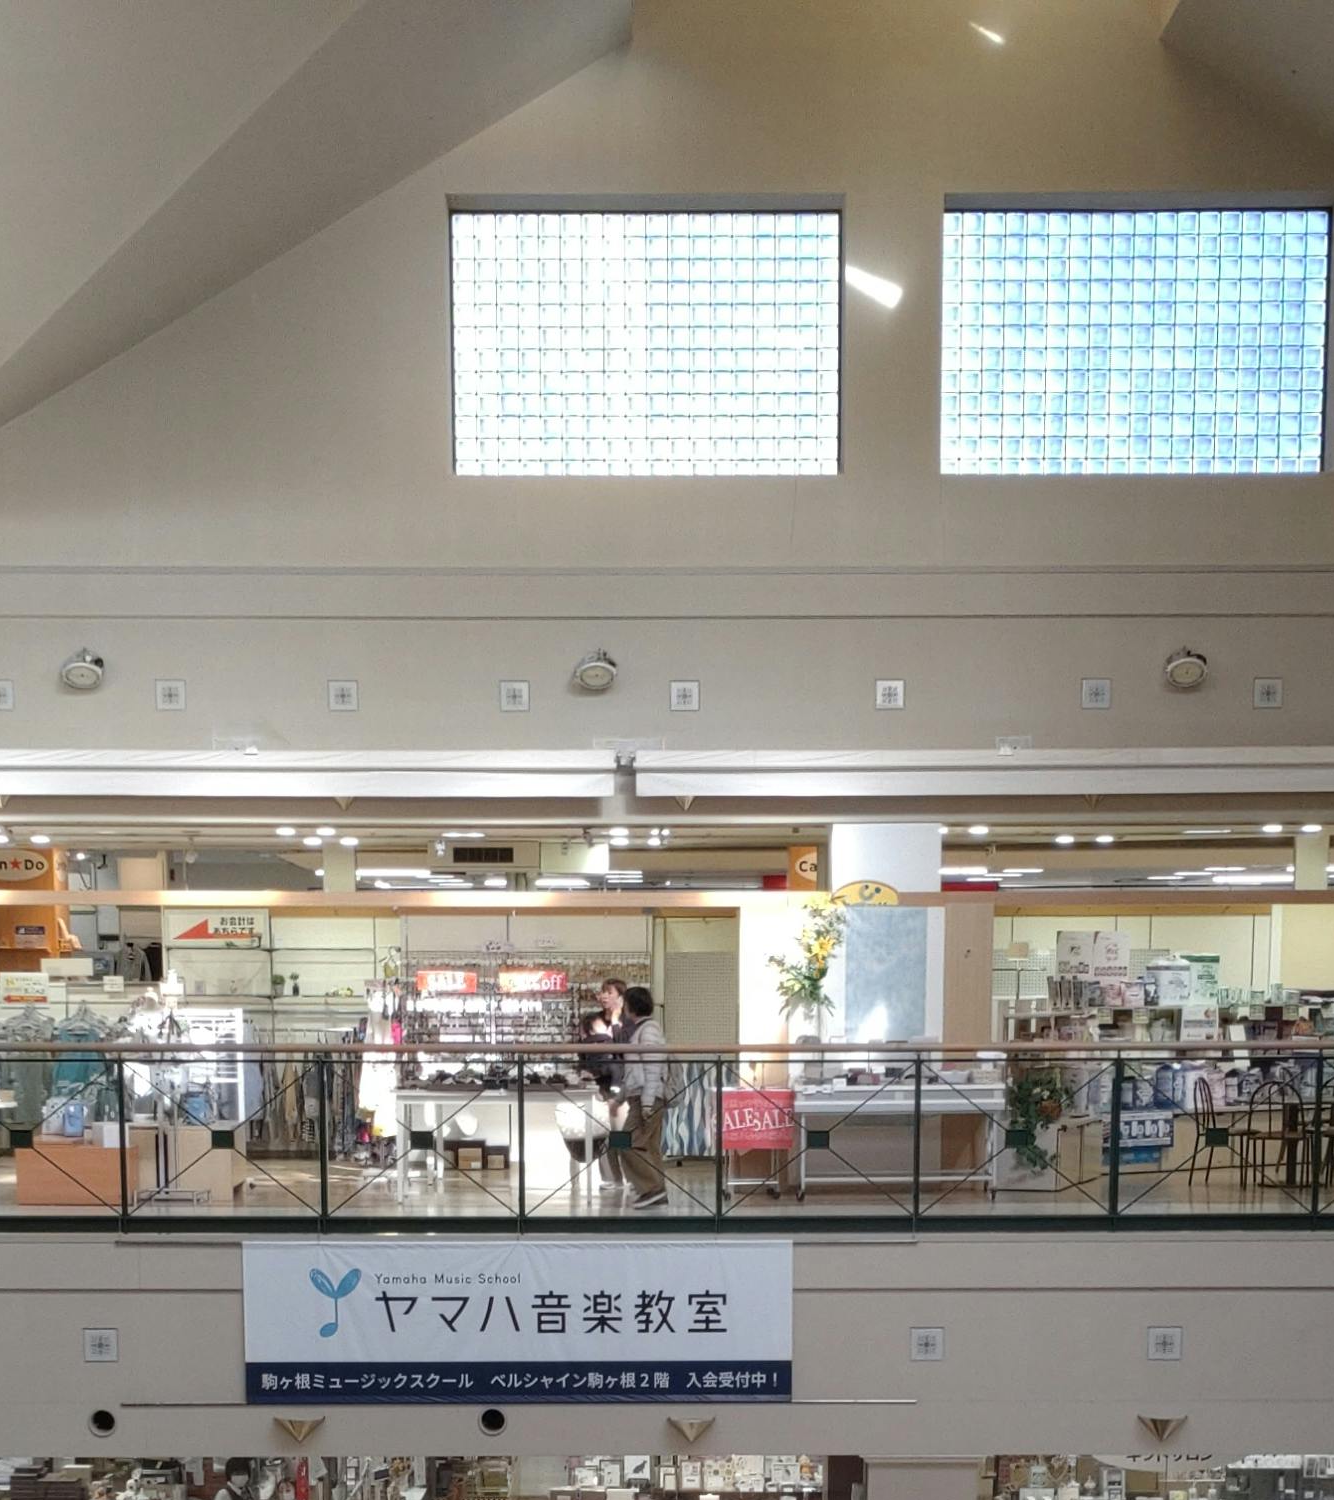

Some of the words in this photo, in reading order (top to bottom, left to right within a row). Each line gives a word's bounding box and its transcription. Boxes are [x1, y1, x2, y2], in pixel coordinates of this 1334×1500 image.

[798, 860, 817, 872] Ca
[219, 916, 255, 927] お会計は
[722, 1107, 755, 1131] ALE
[374, 1273, 428, 1286] Yamaha
[433, 1273, 472, 1285] Music
[477, 1272, 522, 1285] School
[373, 1289, 729, 1335] ヤマハ音楽教室
[261, 1372, 475, 1391] 駒ヶ根ミュージックスクール
